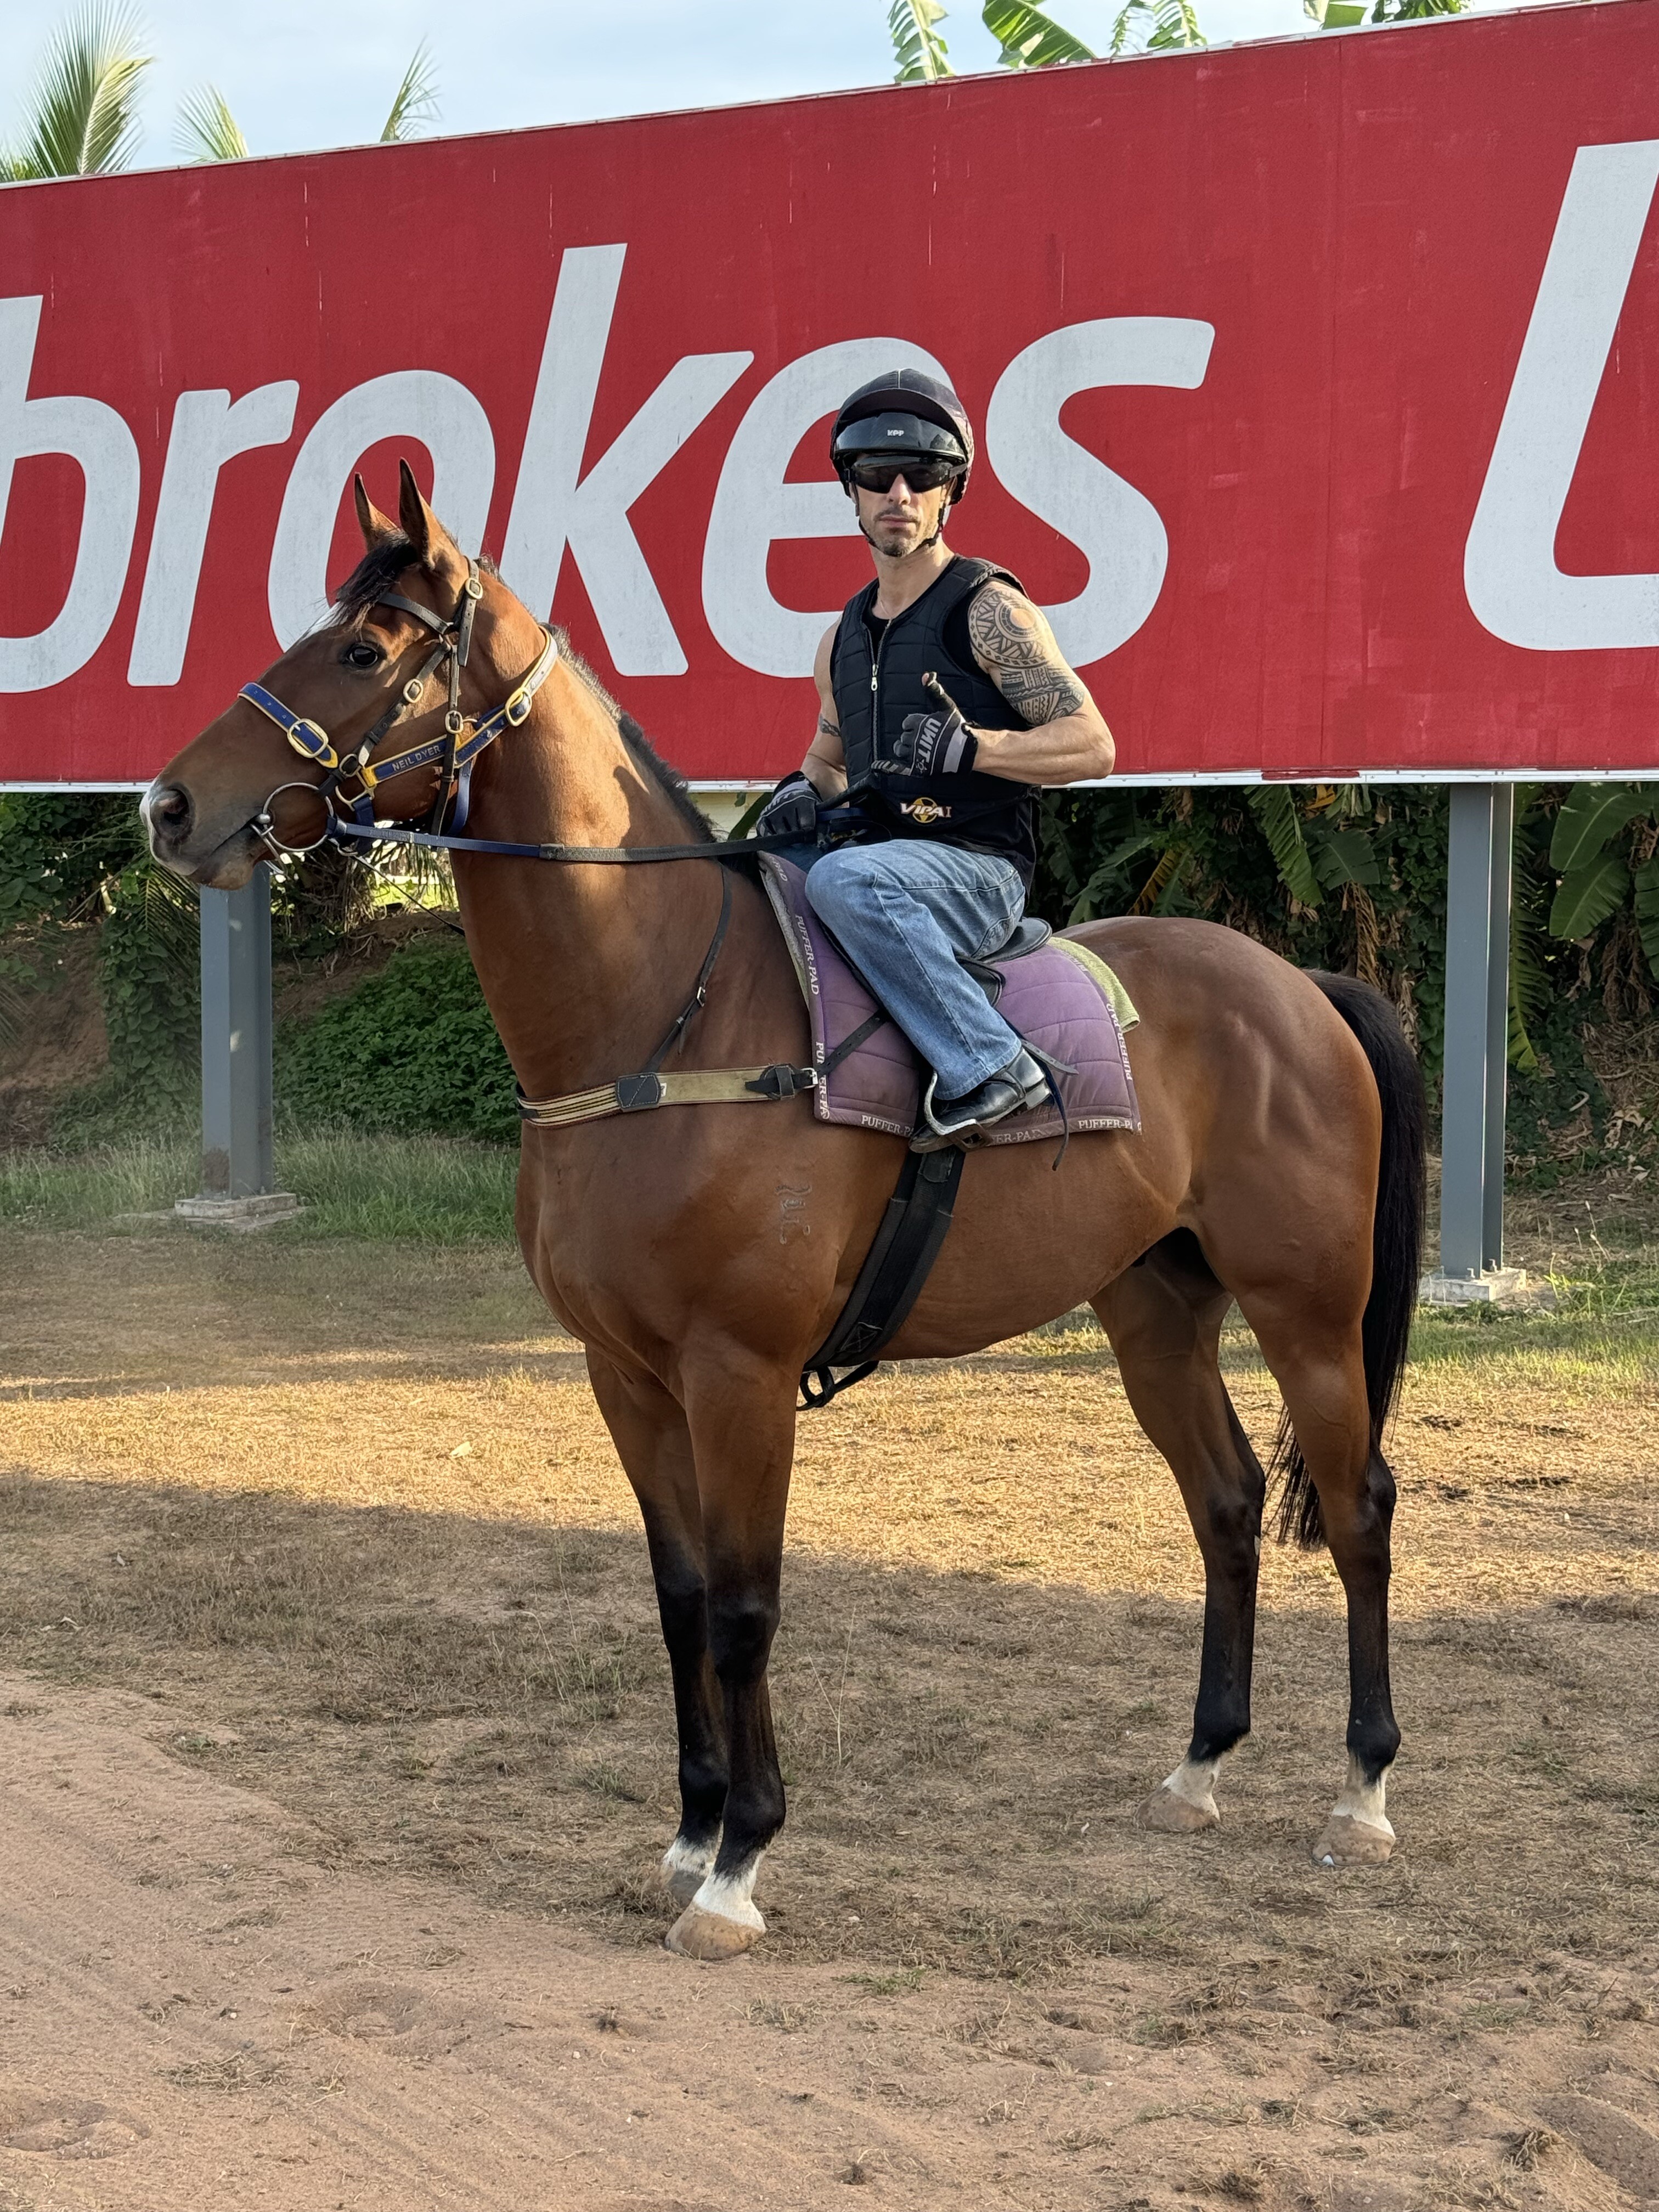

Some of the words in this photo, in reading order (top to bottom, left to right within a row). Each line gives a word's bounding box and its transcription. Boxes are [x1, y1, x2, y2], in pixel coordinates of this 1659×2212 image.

[0, 243, 1216, 693] brokes
[392, 757, 415, 771] NEIL
[415, 745, 441, 761] DYER
[918, 718, 942, 763] UNIT
[795, 913, 820, 995] PUFFER-PAD
